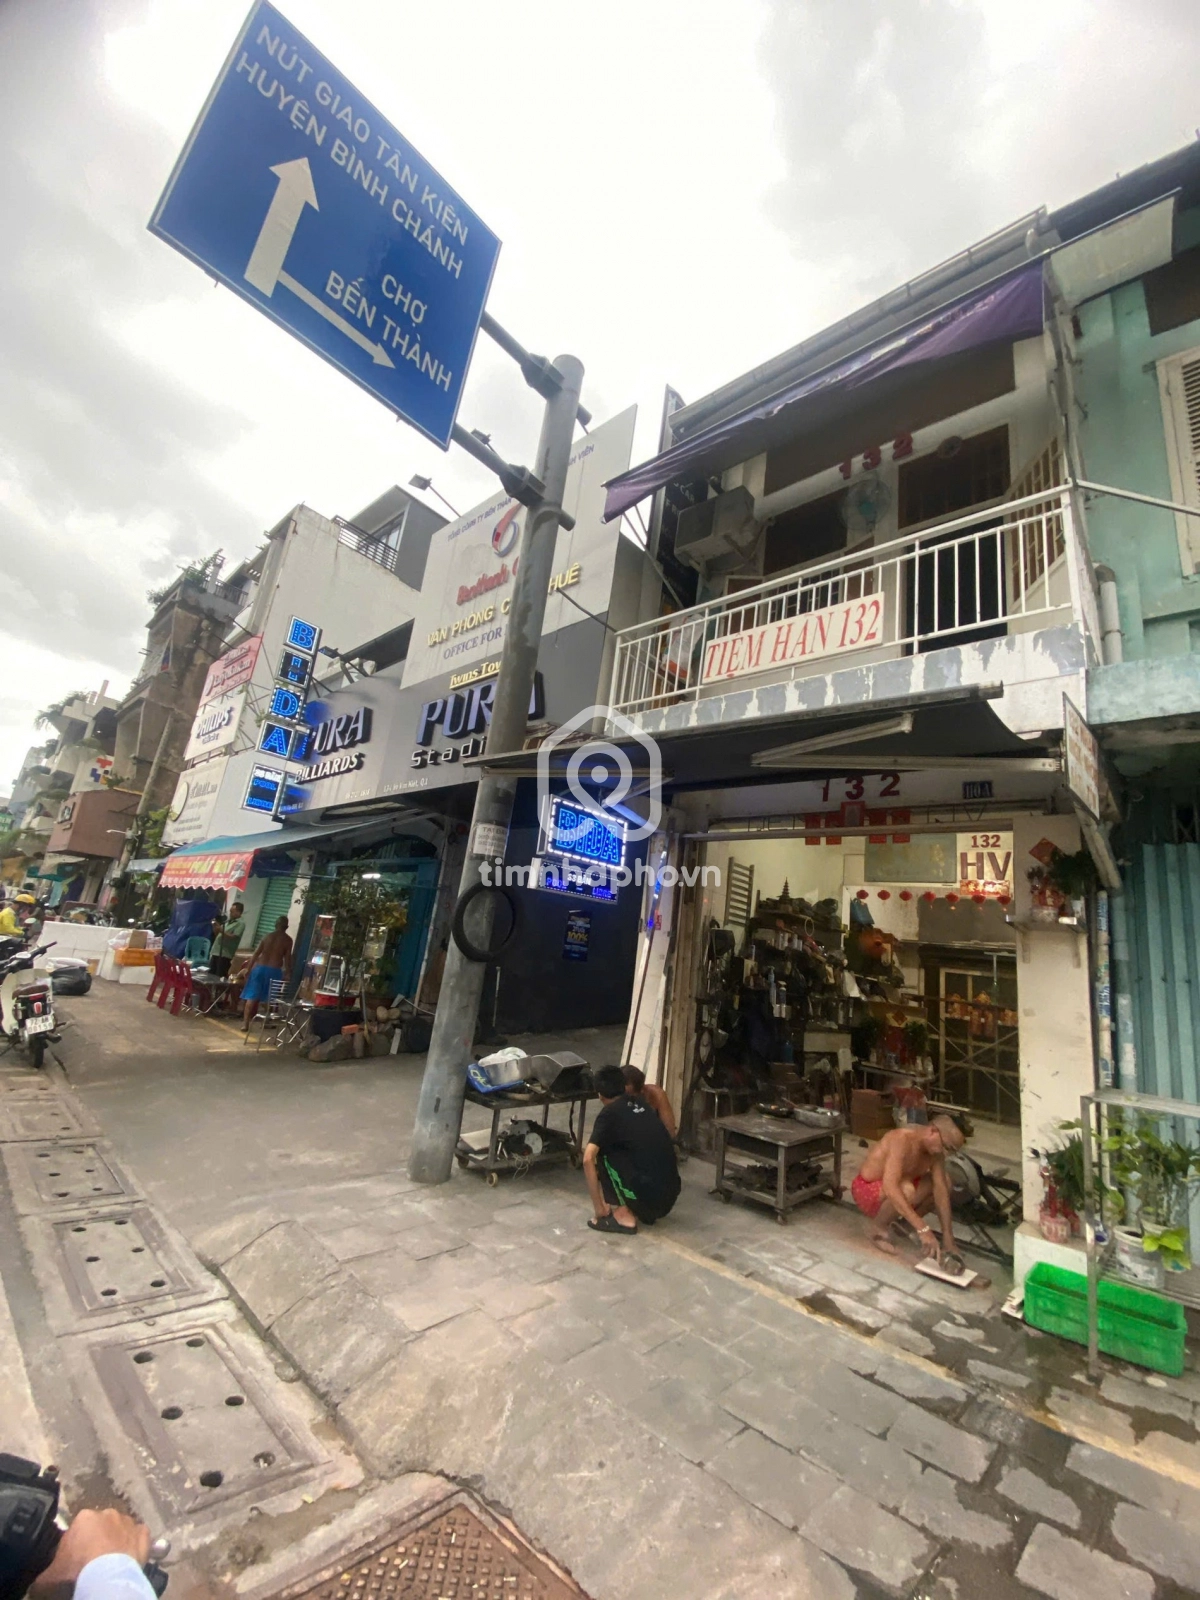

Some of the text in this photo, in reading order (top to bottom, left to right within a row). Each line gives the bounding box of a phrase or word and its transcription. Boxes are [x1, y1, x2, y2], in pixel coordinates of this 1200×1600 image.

[256, 25, 469, 246] NÚT GIAO TÂN KIÊN
[235, 51, 463, 280] HUYỆN BÌNH CHÁNH
[381, 274, 428, 328] CHỢ
[325, 270, 453, 393] BẾN THÀNH
[839, 433, 913, 480] 132
[547, 562, 581, 594] HUÊ
[443, 627, 503, 660] OFFICE FOR
[704, 630, 767, 678] TIỆM
[836, 599, 881, 648] 132
[311, 706, 371, 756] URA
[410, 736, 487, 768] Stadi
[294, 752, 363, 784] BILLIARDS
[822, 771, 900, 802] 132
[556, 808, 619, 863] BIDA
[971, 834, 1001, 848] 132
[960, 852, 1012, 881] HV
